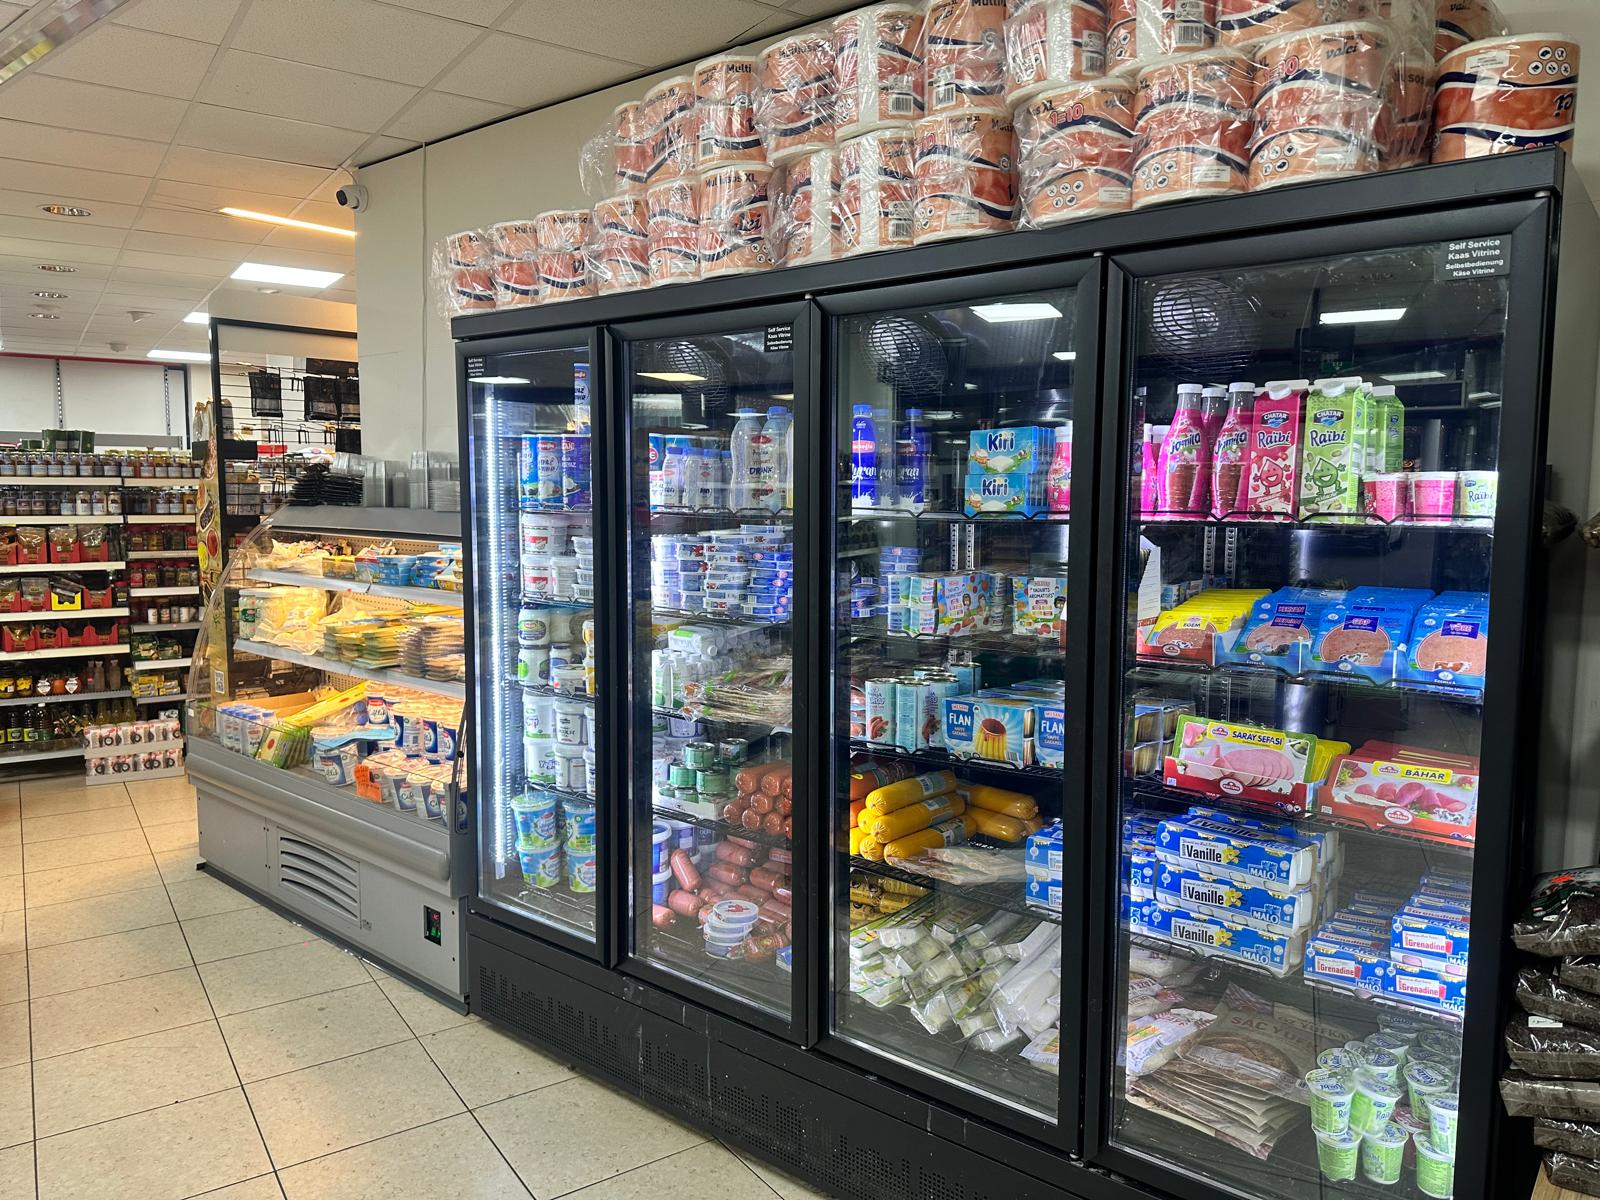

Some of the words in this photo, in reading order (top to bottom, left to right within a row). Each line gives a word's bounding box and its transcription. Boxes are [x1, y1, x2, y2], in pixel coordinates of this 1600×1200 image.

[1050, 103, 1084, 127] 1=10
[1448, 242, 1466, 251] Self
[1467, 239, 1501, 249] Service
[1448, 252, 1470, 261] Kaas
[1471, 249, 1501, 258] Vitrine
[1445, 259, 1504, 270] Selbstbedienung
[1471, 268, 1495, 276] Vitrine
[988, 432, 1015, 451] Kiri
[1257, 431, 1291, 449] Raïbi
[1310, 429, 1347, 447] Raïbi
[852, 464, 877, 483] yran
[982, 478, 1009, 496] Kiri
[949, 712, 971, 726] FLAN
[1041, 720, 1065, 734] FLAN
[1232, 731, 1257, 742] SARAY
[1405, 769, 1446, 780] BAHAR
[1186, 844, 1222, 863] Vanille
[1250, 868, 1276, 880] MALO
[1187, 886, 1224, 905] Vanille
[1252, 911, 1279, 924] MALO
[1178, 925, 1215, 945] Vanille
[1408, 939, 1445, 952] Grenadine
[1243, 950, 1269, 965] MALO
[1320, 963, 1354, 976] Grenadine
[1357, 981, 1380, 992] MALO
[1401, 981, 1439, 996] Grenadine
[1231, 1016, 1268, 1031] SAC
